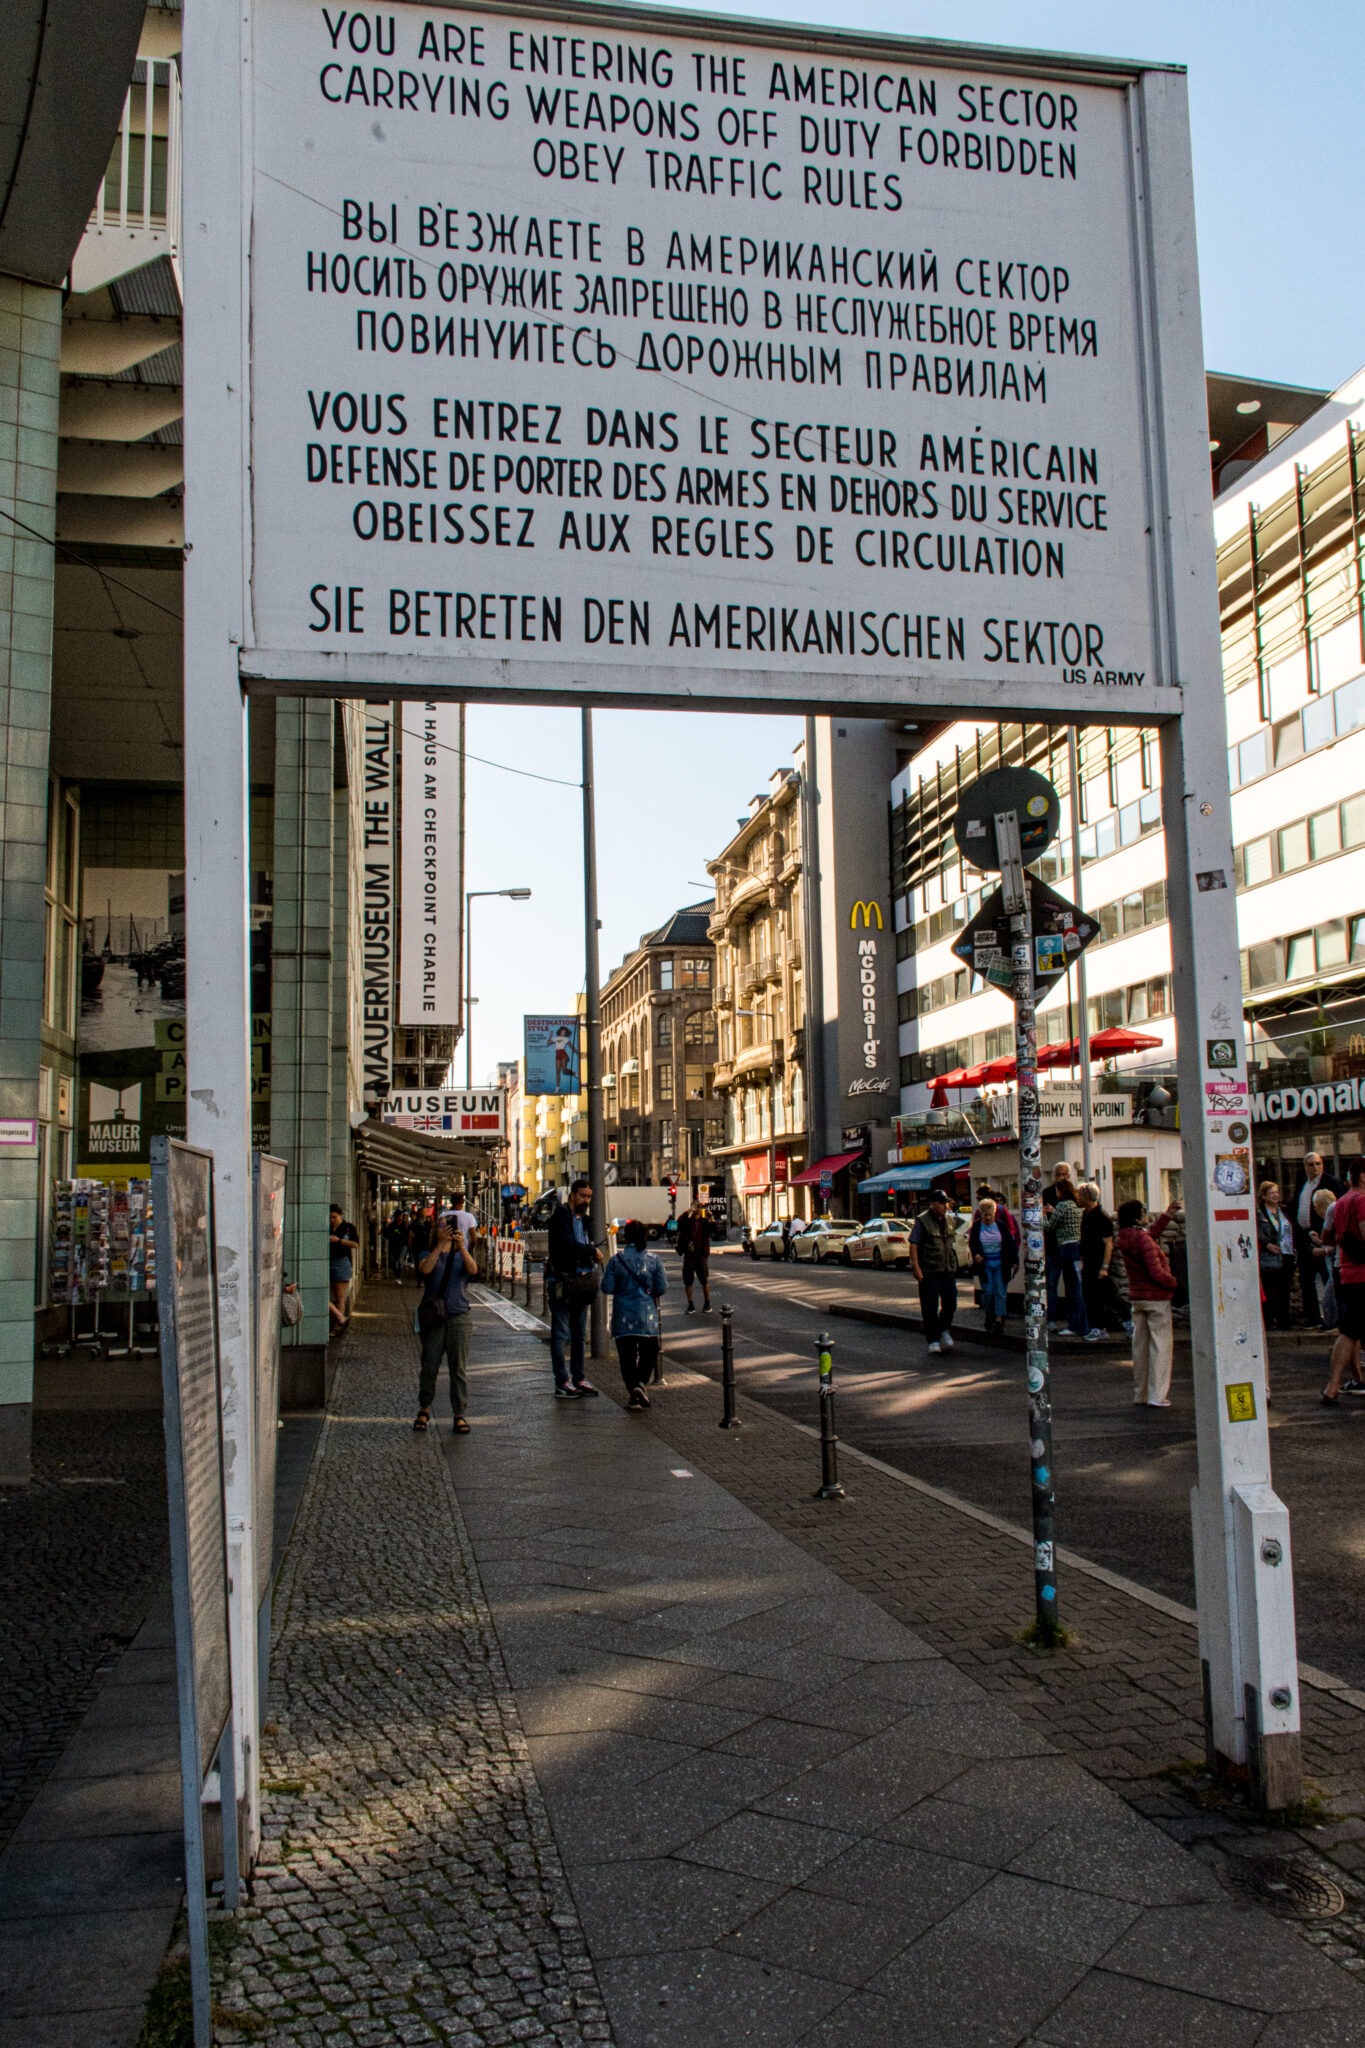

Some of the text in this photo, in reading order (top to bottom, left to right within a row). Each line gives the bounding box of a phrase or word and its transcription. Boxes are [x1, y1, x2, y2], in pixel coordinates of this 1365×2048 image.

[322, 11, 1078, 132] YOU ARE ENTERING THE AMERICAN SECTOR
[319, 63, 1076, 180] CARRYING WEAPONS OFF DUTY FORBIDDEN
[533, 138, 903, 212] OBEY TRAFFIC RULES
[342, 199, 397, 245] ВЫ
[627, 227, 645, 266] В
[666, 231, 938, 293] АМЕРИКАНСКИЙ
[955, 258, 1070, 304] СЕКТОР
[307, 251, 427, 300] НОСИТЬ
[437, 261, 563, 311] ОРУЖИЕ
[764, 290, 783, 329] В
[796, 293, 997, 349] НЕСЛУЖЕБНОЕ
[1009, 312, 1098, 357] ВРЕМЯ
[635, 332, 842, 386] ДОРОЖНЫМ
[865, 350, 1047, 404] ПРАВИЛАМ
[307, 390, 1098, 485] VOUS ENTREZ DANS LE SECTEUR AMÉRICAIN
[306, 443, 1108, 531] DEFENSE DE PORTER DES ARMES EN DEHORS DU SERVICE
[352, 500, 1064, 579] OBEISSEZ AUX REGLES DE CIRCULATION
[308, 583, 1105, 668] SIE BETRETEN DEN AMERIKANISCHEN SEKTOR
[1062, 668, 1145, 687] US ARMY
[365, 719, 390, 793] WALL
[424, 719, 437, 766] HAUS
[365, 800, 390, 849] THE
[424, 773, 437, 800] AM
[423, 807, 437, 926] CHECKPOINT
[364, 863, 390, 1091] MAUERMUSEUM
[423, 933, 437, 1012] CHARLIE
[858, 939, 881, 1070] McDonald's
[89, 1124, 141, 1140] MAUER
[384, 1095, 500, 1113] MUSEUM
[1039, 1102, 1065, 1118] ARMY
[1069, 1101, 1126, 1118] CHKPOINT
[89, 1140, 141, 1153] MUSEUM
